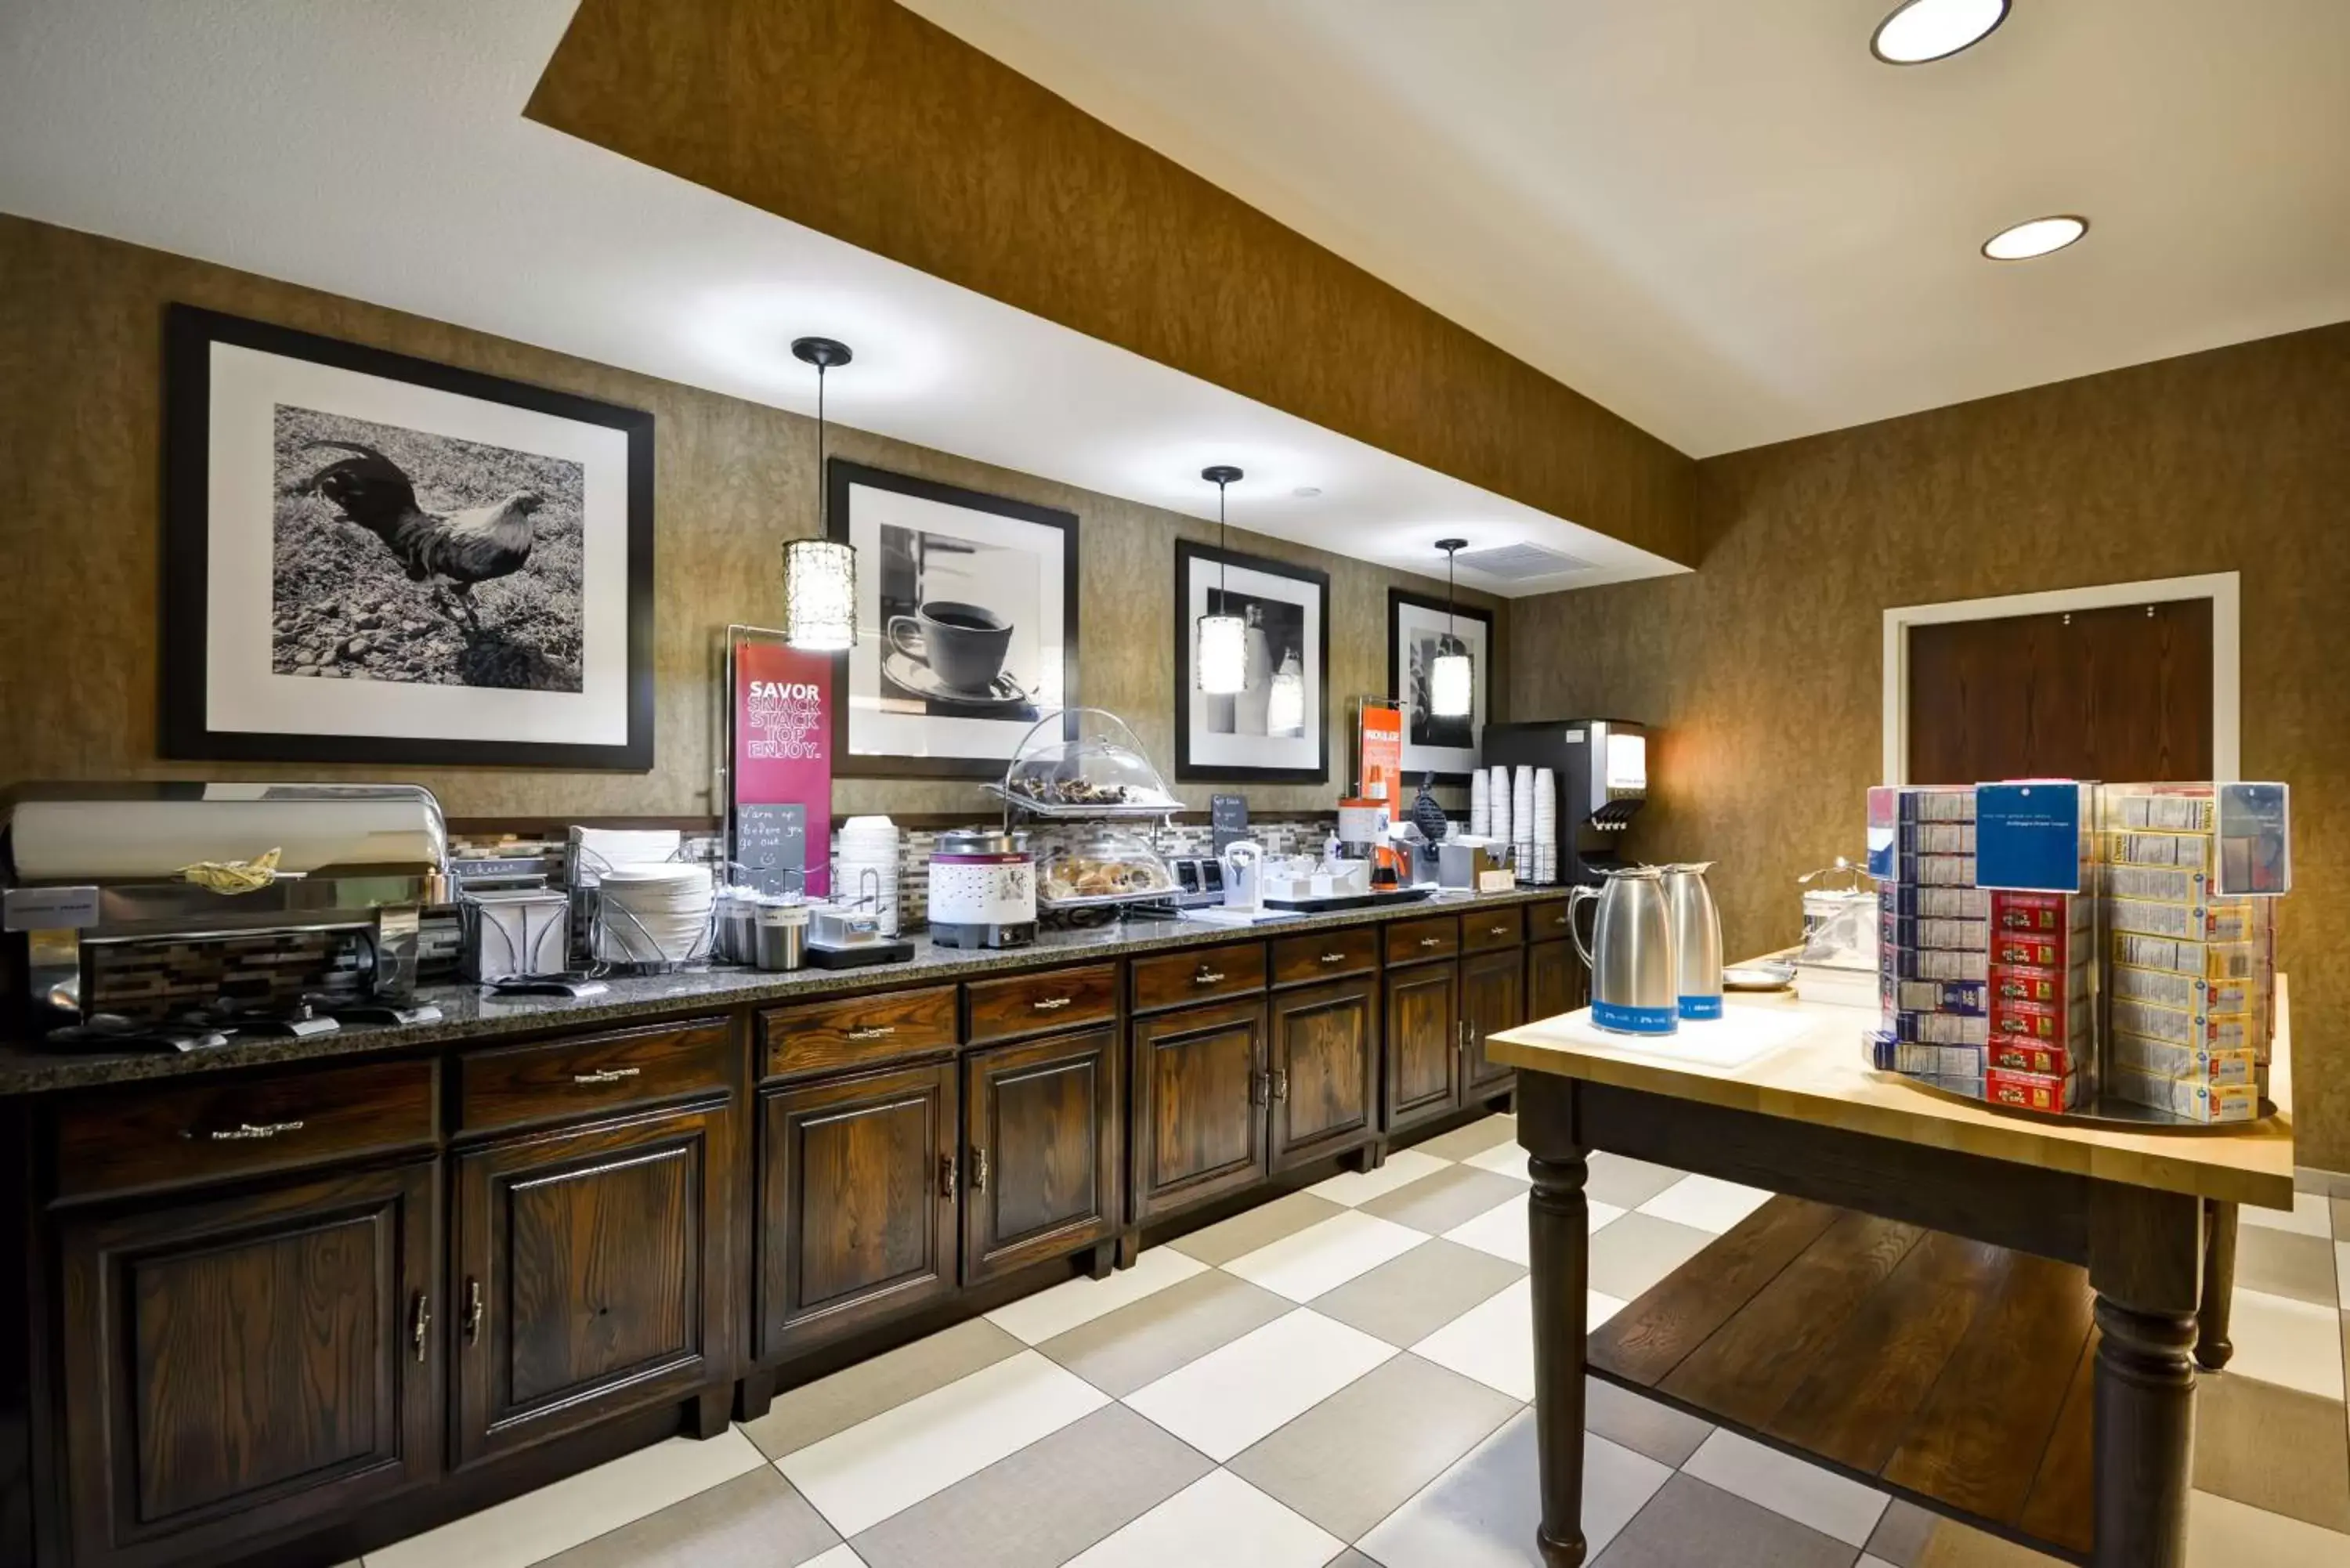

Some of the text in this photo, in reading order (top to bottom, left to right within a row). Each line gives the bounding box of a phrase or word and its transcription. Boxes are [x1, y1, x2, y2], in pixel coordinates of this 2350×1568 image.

[750, 681, 819, 701] SAVOR
[747, 695, 822, 714] SNACK
[751, 710, 819, 730] STACK
[765, 725, 806, 743] TOP
